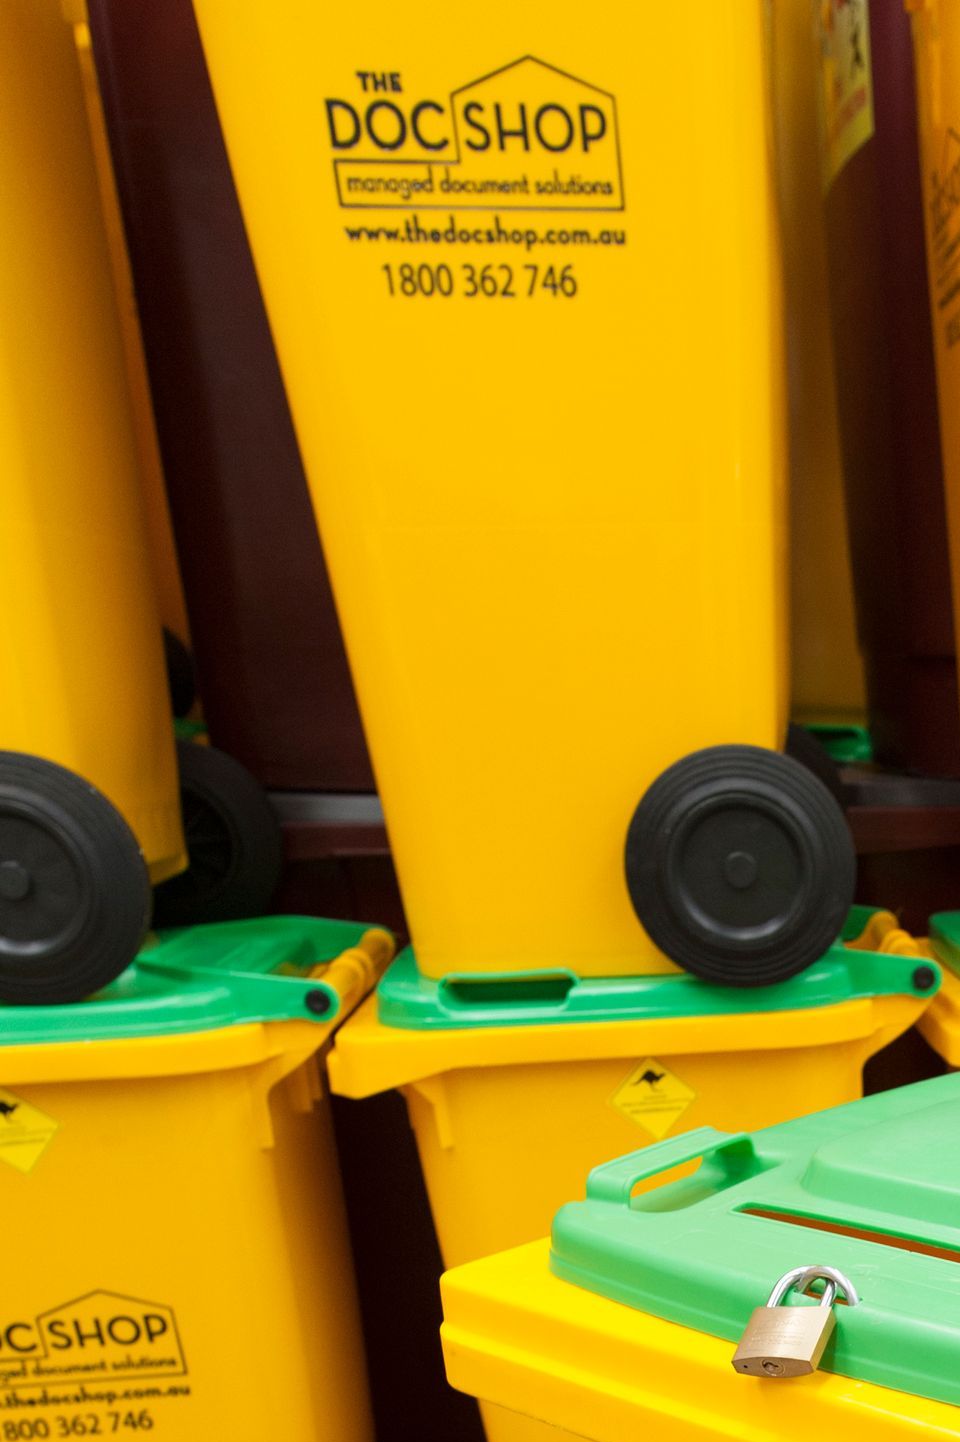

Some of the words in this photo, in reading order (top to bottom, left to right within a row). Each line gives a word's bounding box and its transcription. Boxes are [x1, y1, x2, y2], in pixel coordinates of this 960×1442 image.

[356, 70, 403, 93] THE
[325, 98, 449, 151] DOC
[463, 100, 607, 153] SHOP
[346, 165, 433, 200] managed
[441, 166, 528, 194] document
[535, 169, 613, 195] solutions
[345, 214, 626, 250] www.thedocshop.com.au
[383, 263, 453, 296] 1800
[462, 264, 515, 297] 362
[523, 265, 577, 297] 746
[48, 1314, 167, 1350] SHOP
[2, 1417, 50, 1442] 800
[56, 1412, 102, 1438] 362
[105, 1409, 153, 1433] 746
